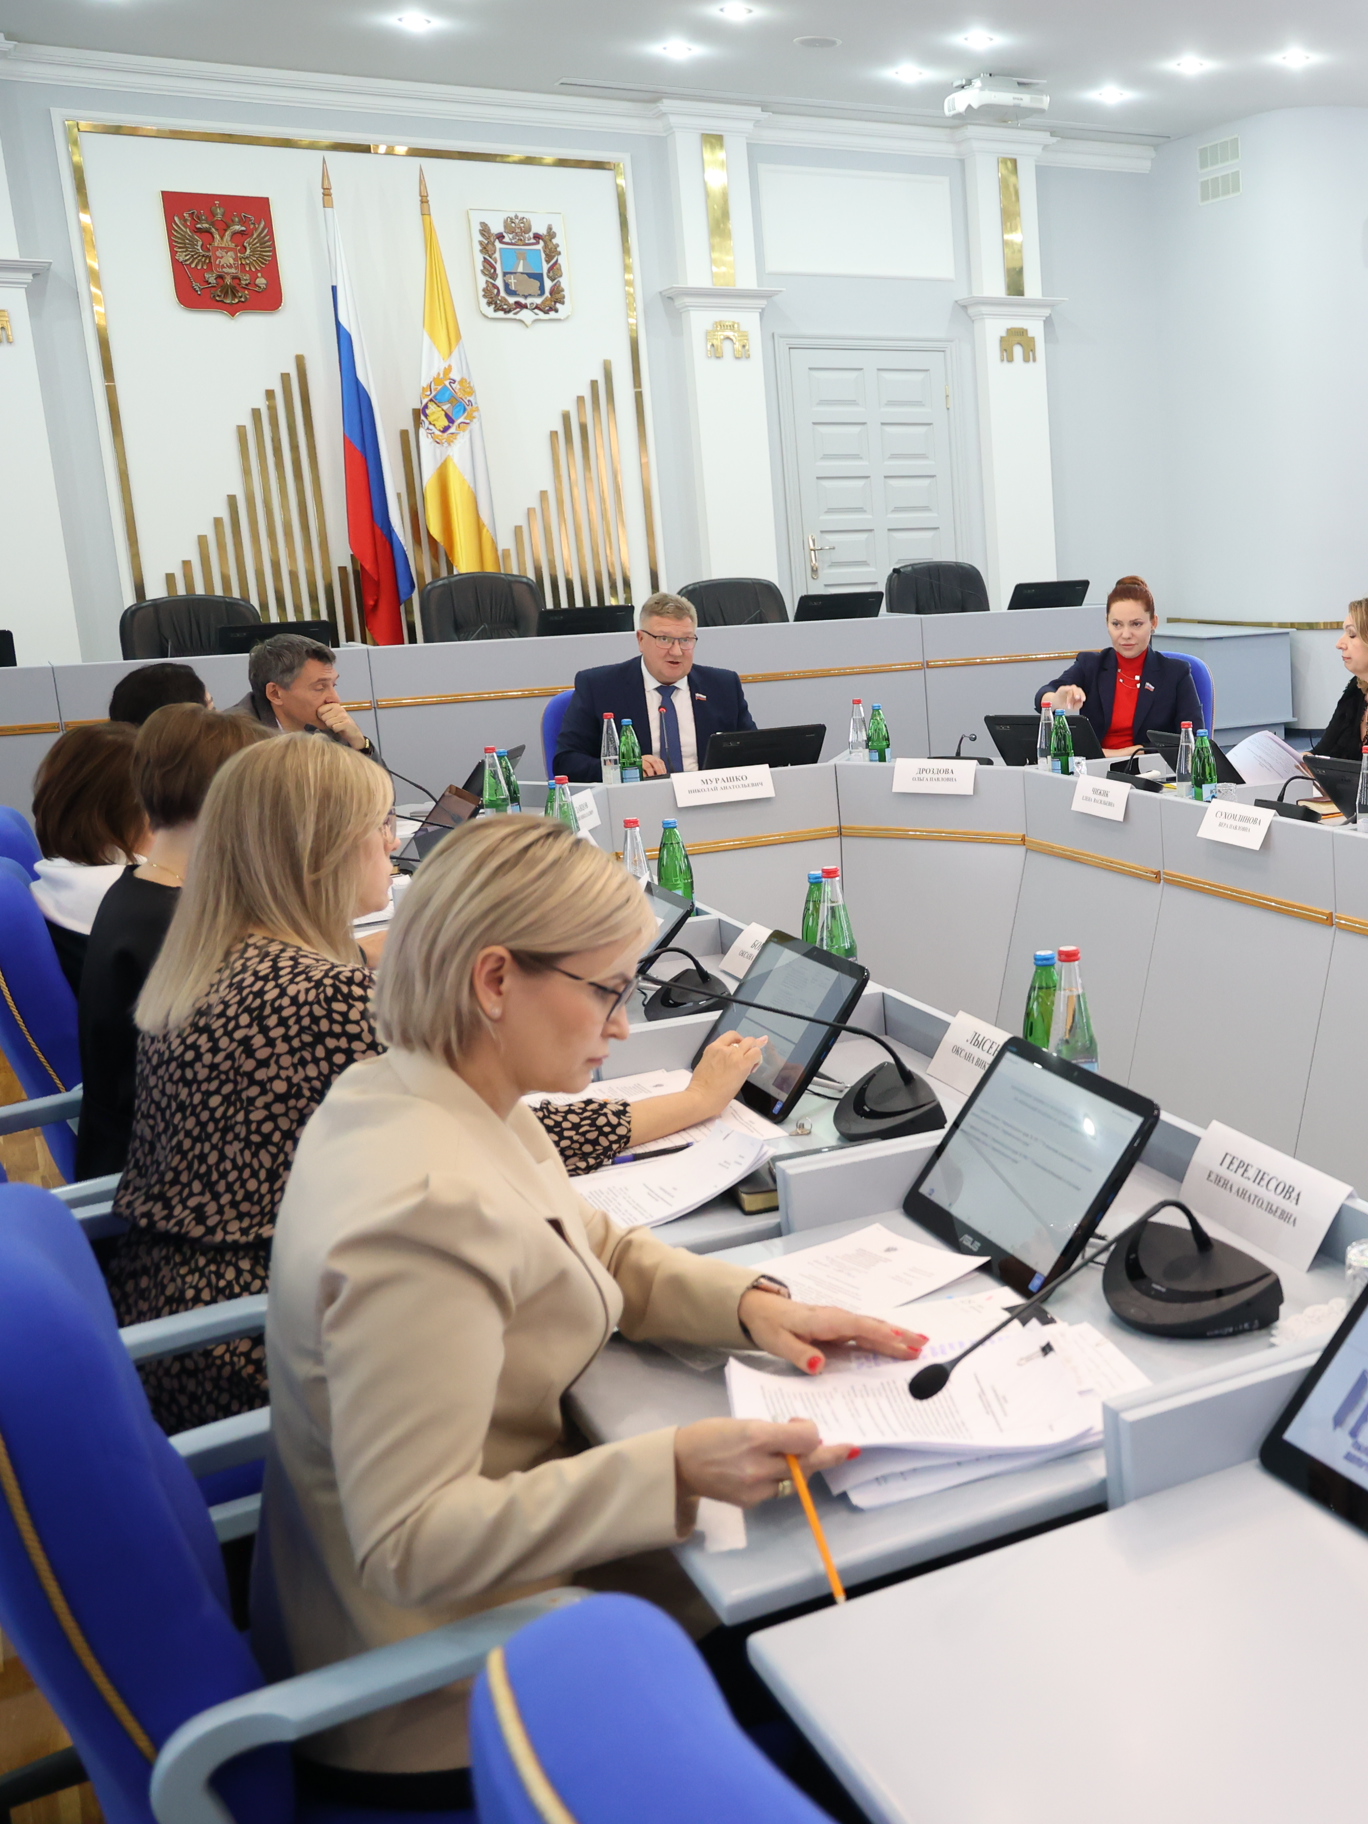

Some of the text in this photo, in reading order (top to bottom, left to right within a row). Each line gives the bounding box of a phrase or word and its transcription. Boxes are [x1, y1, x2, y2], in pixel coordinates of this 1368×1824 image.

[700, 775, 748, 786] МУРАШКО
[915, 768, 955, 776] ДРОЗДОВА
[951, 1044, 976, 1064] ОКСАНА
[1205, 1170, 1298, 1228] ЕЛЕНА АНАТОЛЬЕВНА
[959, 1234, 982, 1252] ASUS
